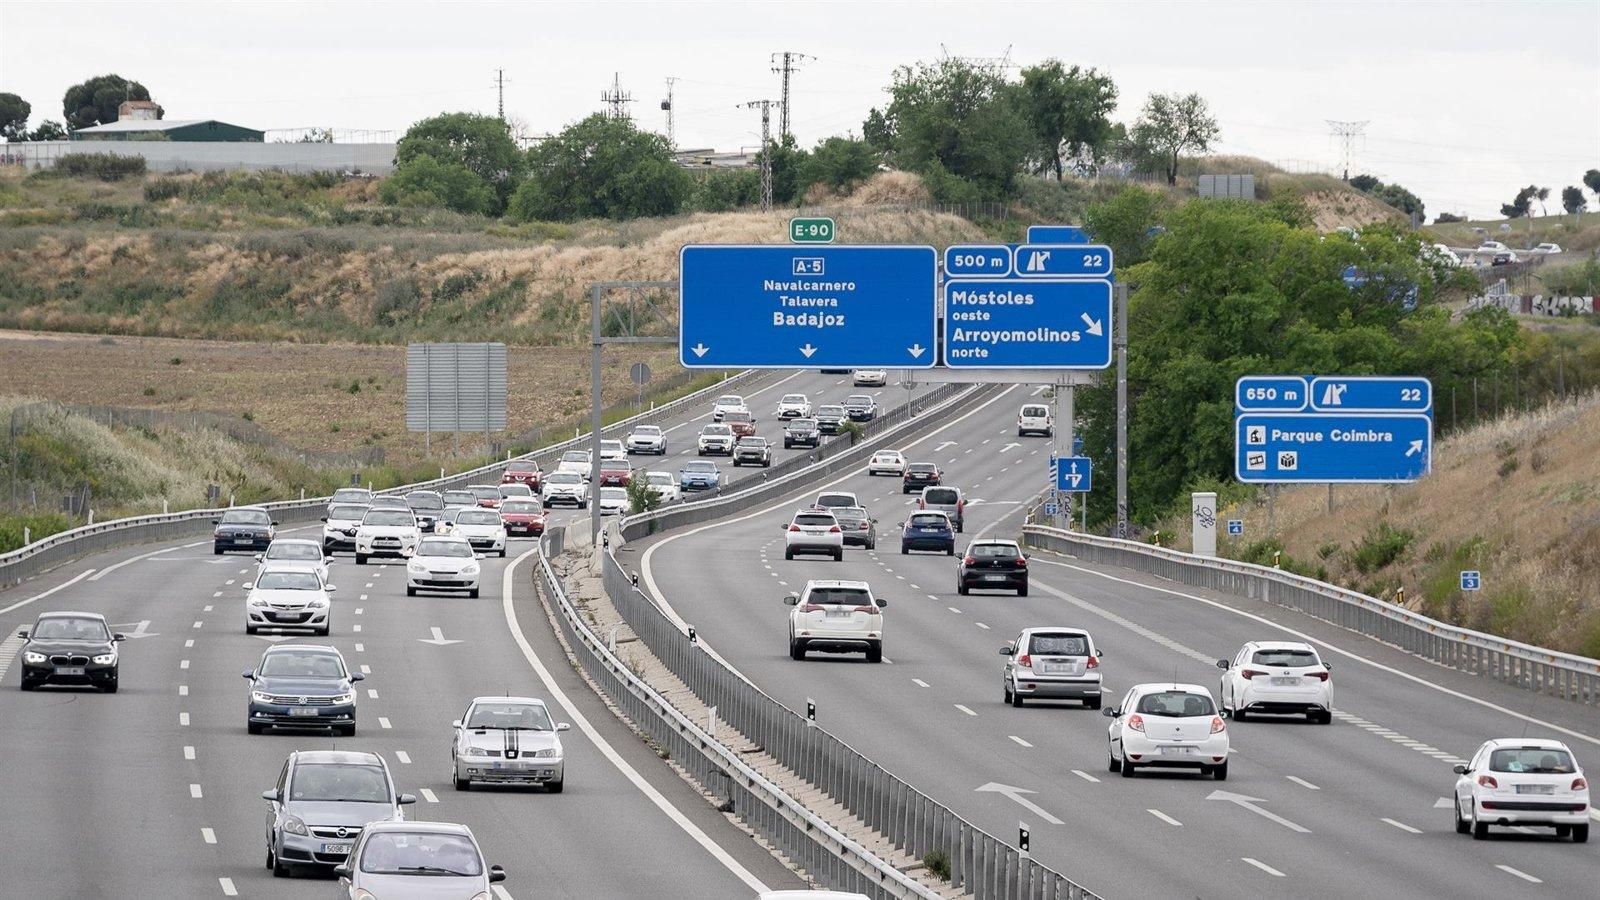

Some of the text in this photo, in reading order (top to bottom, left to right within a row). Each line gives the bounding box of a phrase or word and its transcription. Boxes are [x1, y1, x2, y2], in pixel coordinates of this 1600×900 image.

[796, 224, 829, 236] E-90
[796, 260, 821, 272] A-5
[954, 254, 1003, 267] 500 m
[1083, 254, 1103, 267] 22
[764, 279, 856, 291] Navalcarnero
[779, 295, 838, 307] Talavera
[952, 290, 1034, 305] Móstoles
[773, 312, 845, 328] Badajoz
[952, 310, 991, 321] oeste
[952, 327, 1081, 344] Arroyomolinos
[951, 346, 989, 358] norte
[1246, 388, 1298, 400] 650 m
[1401, 388, 1421, 401] 22
[1271, 428, 1393, 443] Parque Coimbra
[1467, 579, 1474, 588] 3
